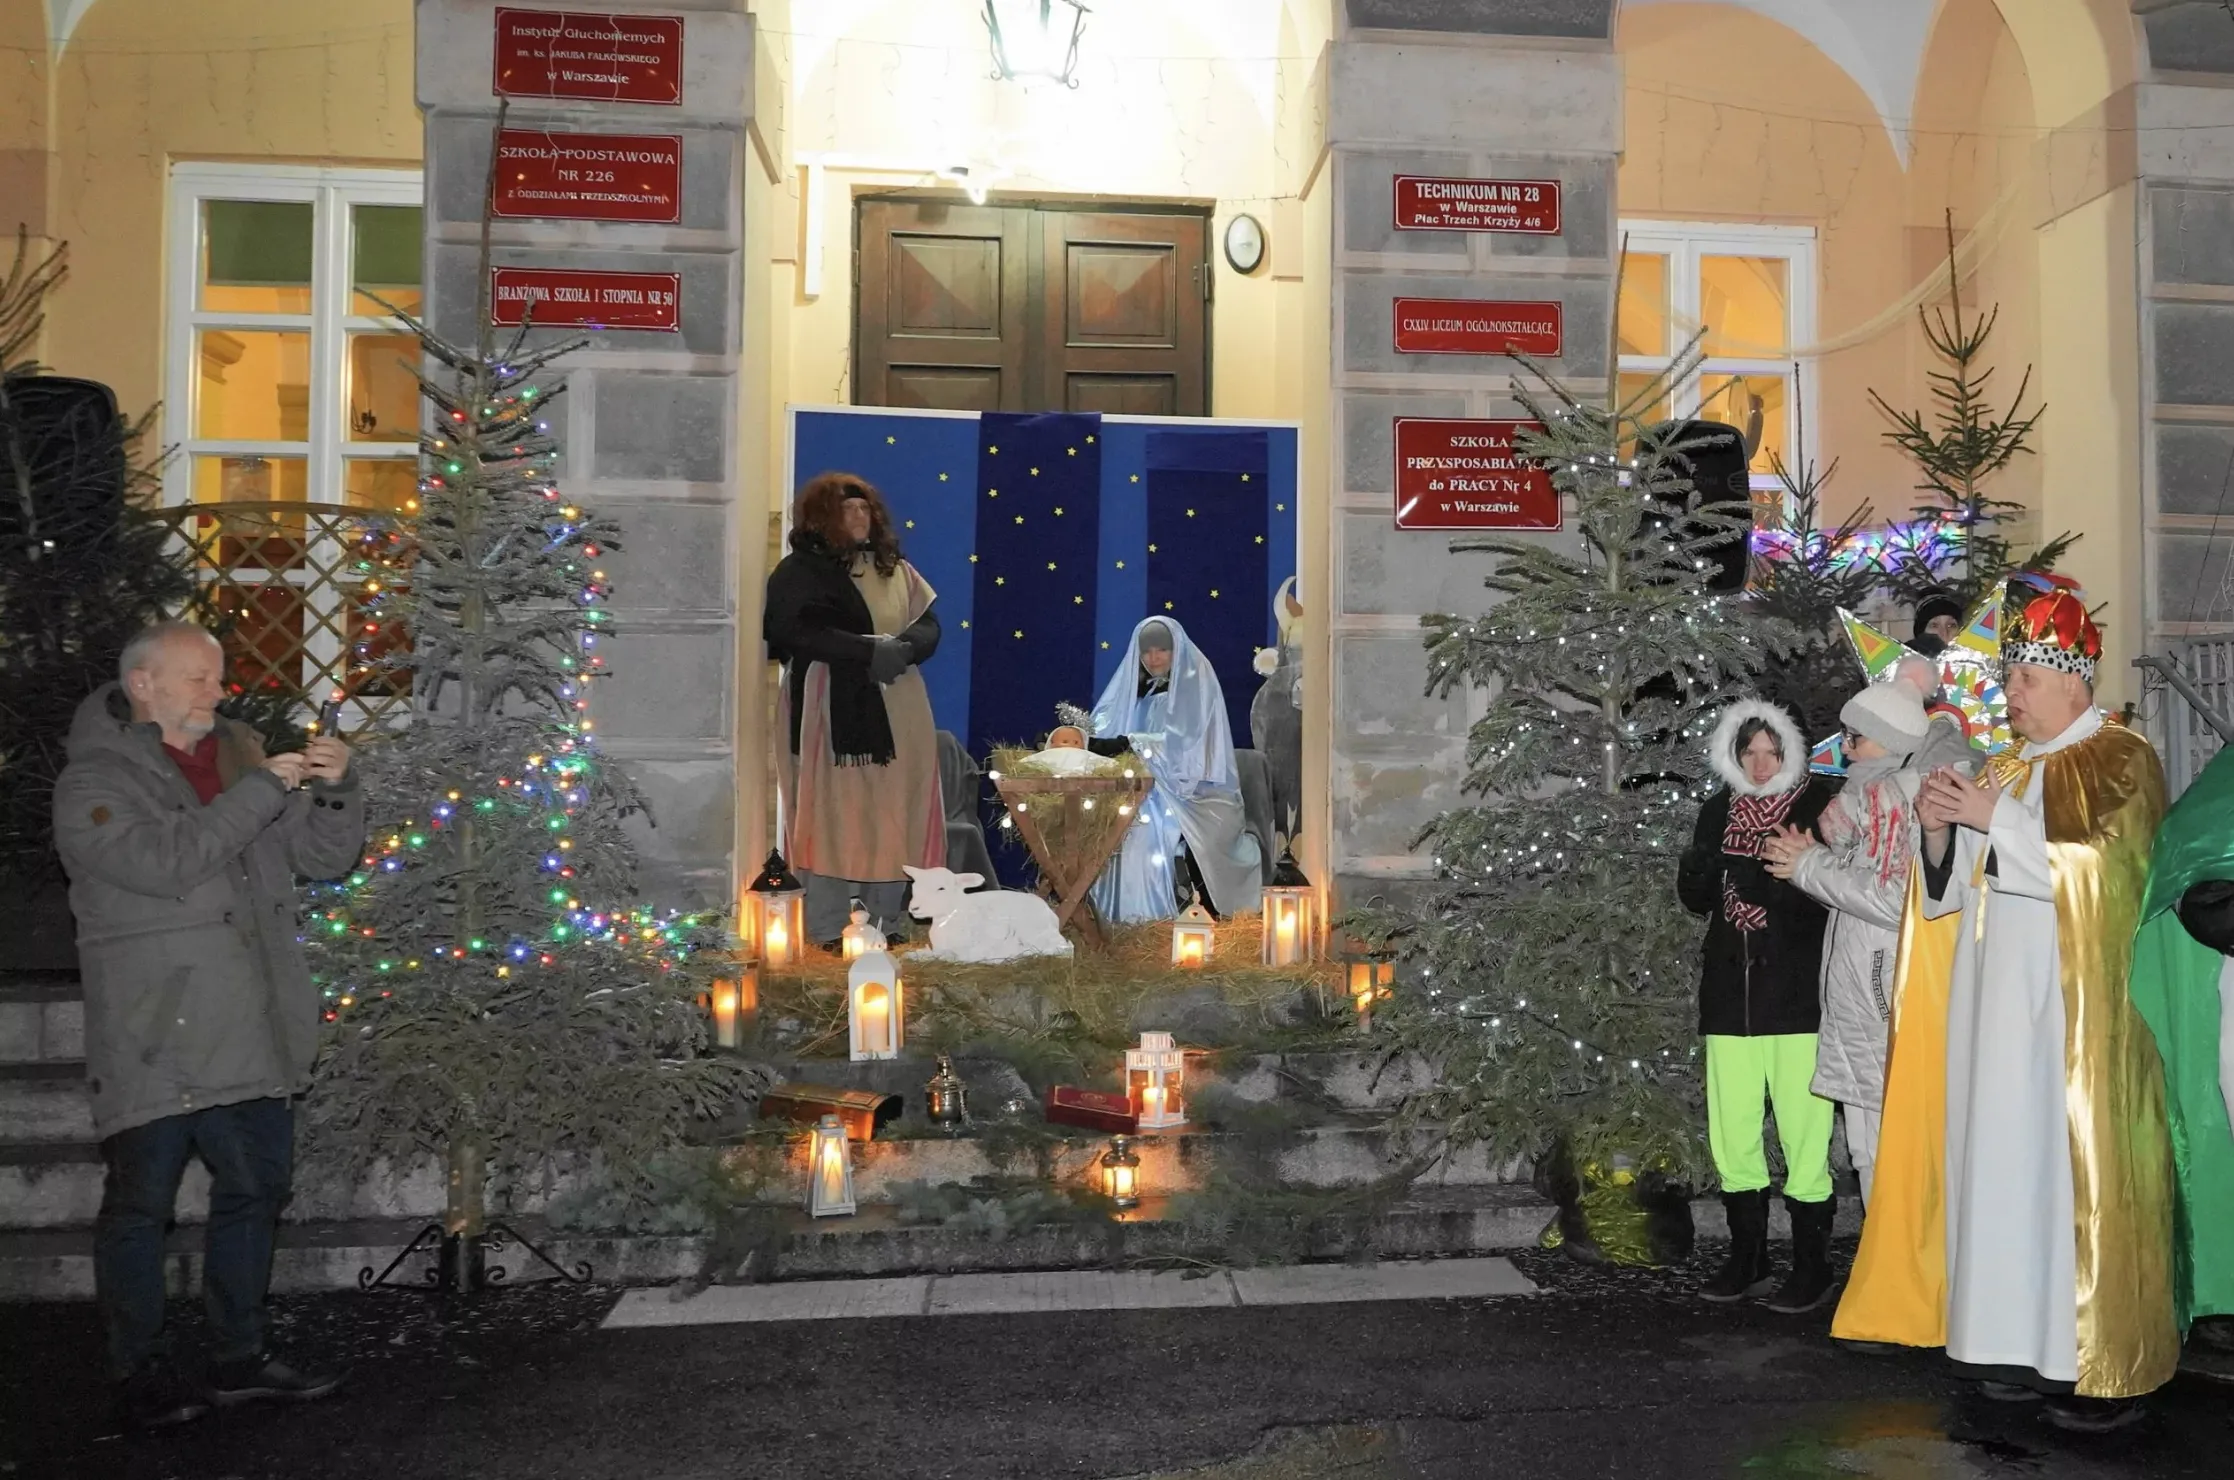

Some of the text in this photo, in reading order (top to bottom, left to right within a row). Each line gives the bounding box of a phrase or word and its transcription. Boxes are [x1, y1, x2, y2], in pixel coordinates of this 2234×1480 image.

[512, 25, 665, 44] Instytut Głuchoniemych
[551, 51, 585, 61] JAKUBA
[547, 70, 630, 84] w Warszawie
[500, 147, 675, 164] SZKOŁA PODSTAWOWA
[558, 169, 614, 182] NR 226
[517, 190, 578, 200] ODDZIAŁAMI
[580, 192, 666, 205] PRZEDSZKOLNYMI
[1415, 182, 1540, 202] TECHNIKUM NR 28
[1440, 201, 1517, 214] w Warszawie
[1443, 214, 1480, 225] Trzech
[1484, 215, 1521, 228] Krzyży
[1524, 217, 1541, 227] 4/6
[498, 284, 673, 306] BRANŻOWA SZKOŁA I STOPNIA NR 50
[1403, 318, 1554, 336] CXXIV LICEUM OGÓLNOKSZTAŁCĄCE
[1450, 436, 1509, 448] SZKOŁA
[1429, 479, 1532, 491] do PRACY Nr 4
[1440, 501, 1520, 513] w Warszawie
